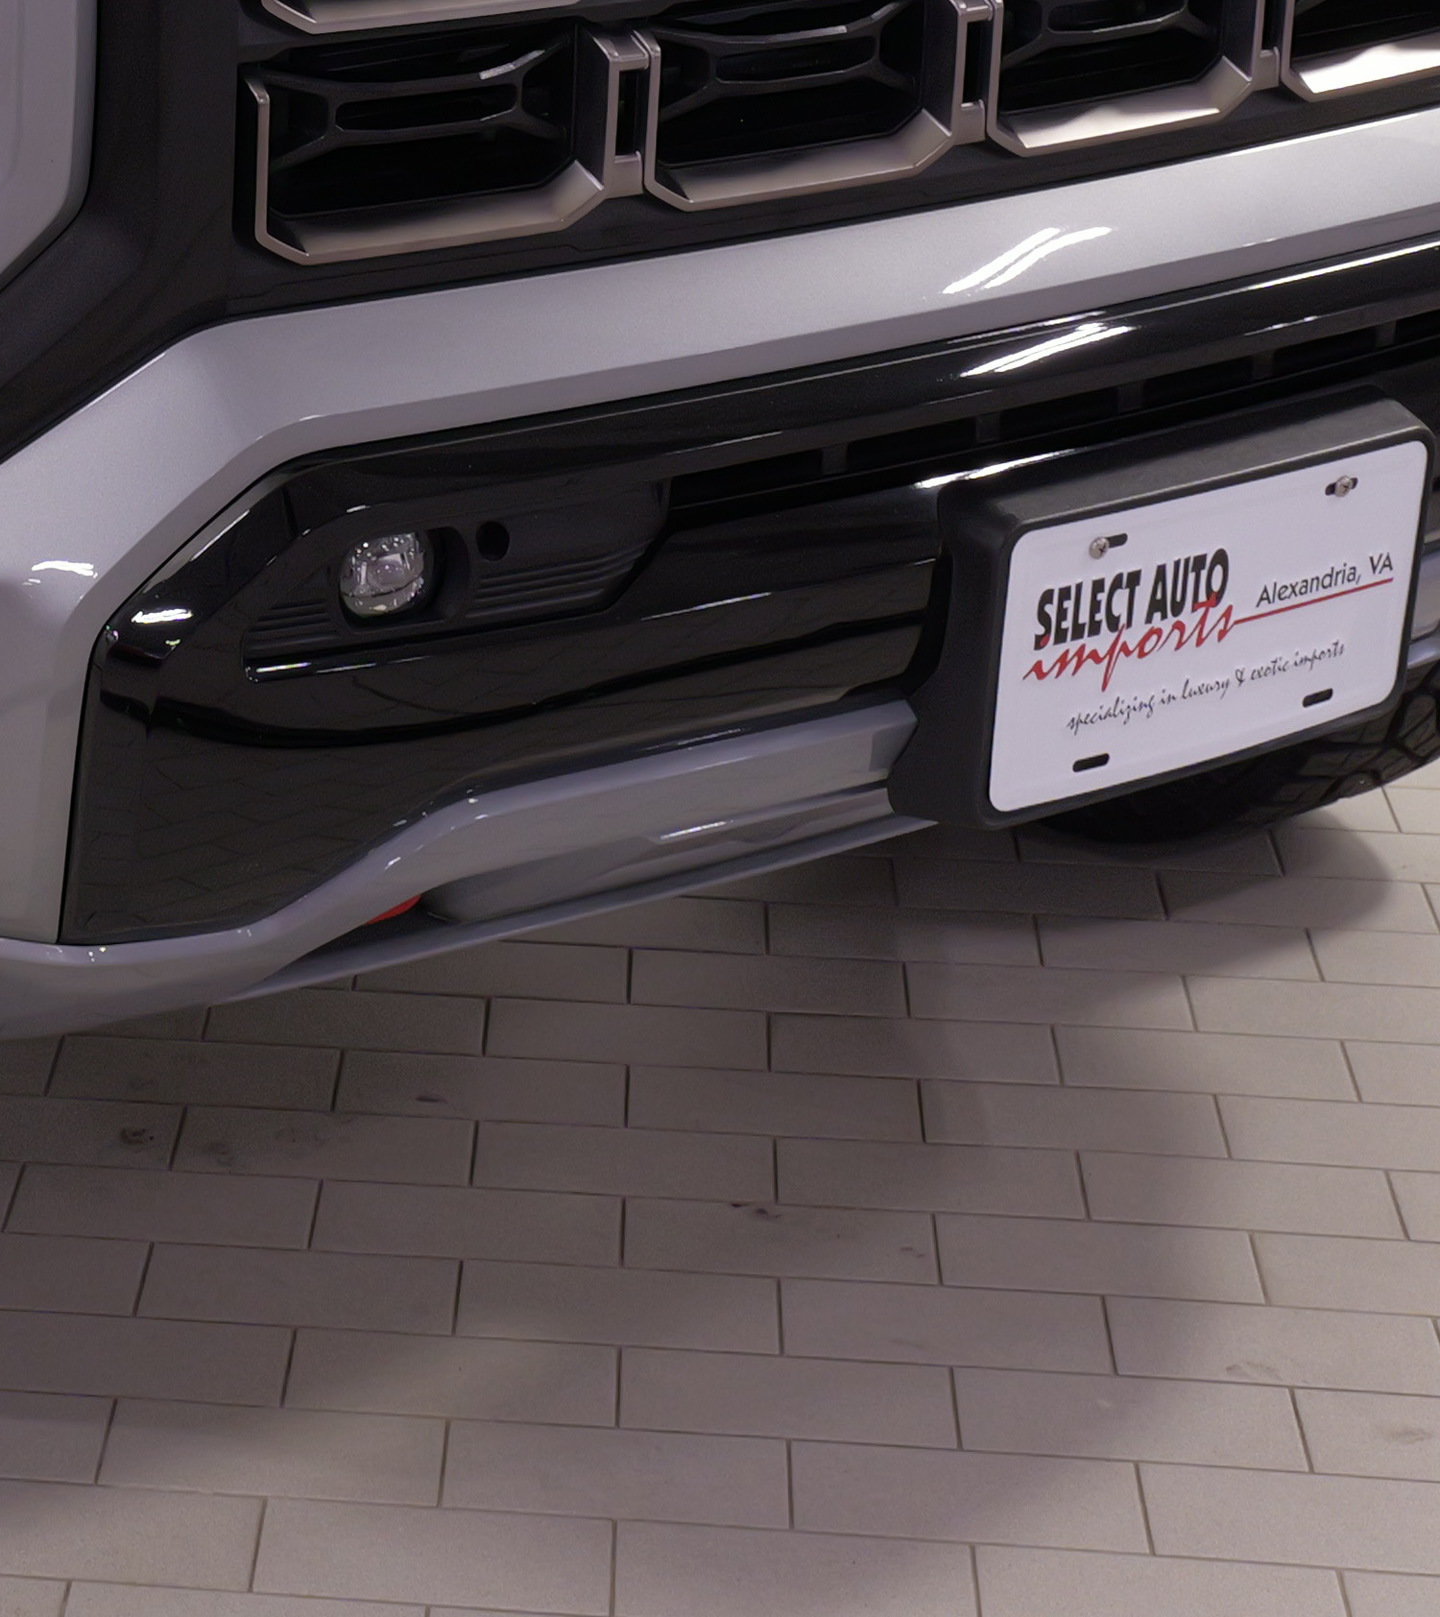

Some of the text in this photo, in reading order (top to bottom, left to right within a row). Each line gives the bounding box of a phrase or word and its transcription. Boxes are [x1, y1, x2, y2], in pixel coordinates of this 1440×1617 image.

[1033, 547, 1229, 651] SELECT AUTO
[1255, 551, 1393, 608] Alexandria, VA
[1022, 591, 1234, 692] imports
[1066, 640, 1345, 735] specializing in luxury & exotic imports
